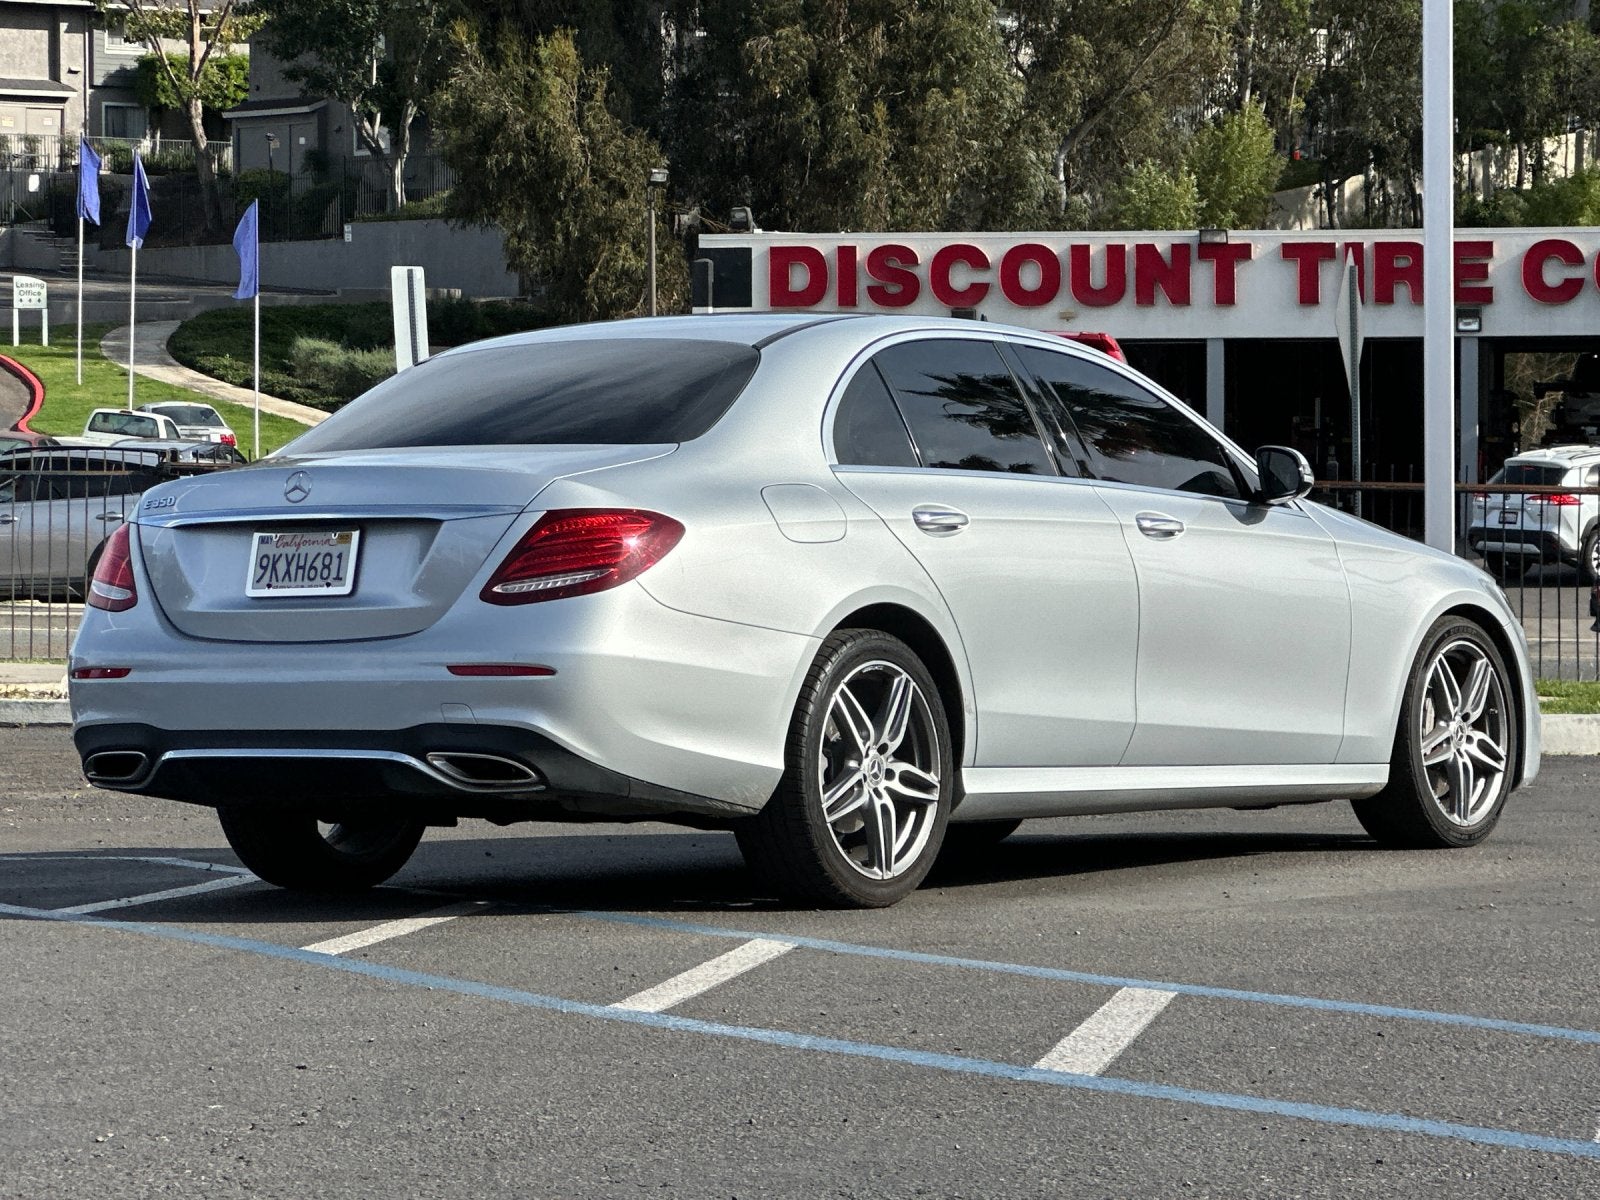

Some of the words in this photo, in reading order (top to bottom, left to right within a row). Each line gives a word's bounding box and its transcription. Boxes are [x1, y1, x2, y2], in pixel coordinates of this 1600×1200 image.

[769, 243, 1252, 308] DISCOUNT
[1522, 238, 1600, 305] C
[144, 496, 176, 510] E350
[260, 535, 273, 545] MAY
[275, 533, 337, 552] California
[255, 551, 343, 584] 9KXH681
